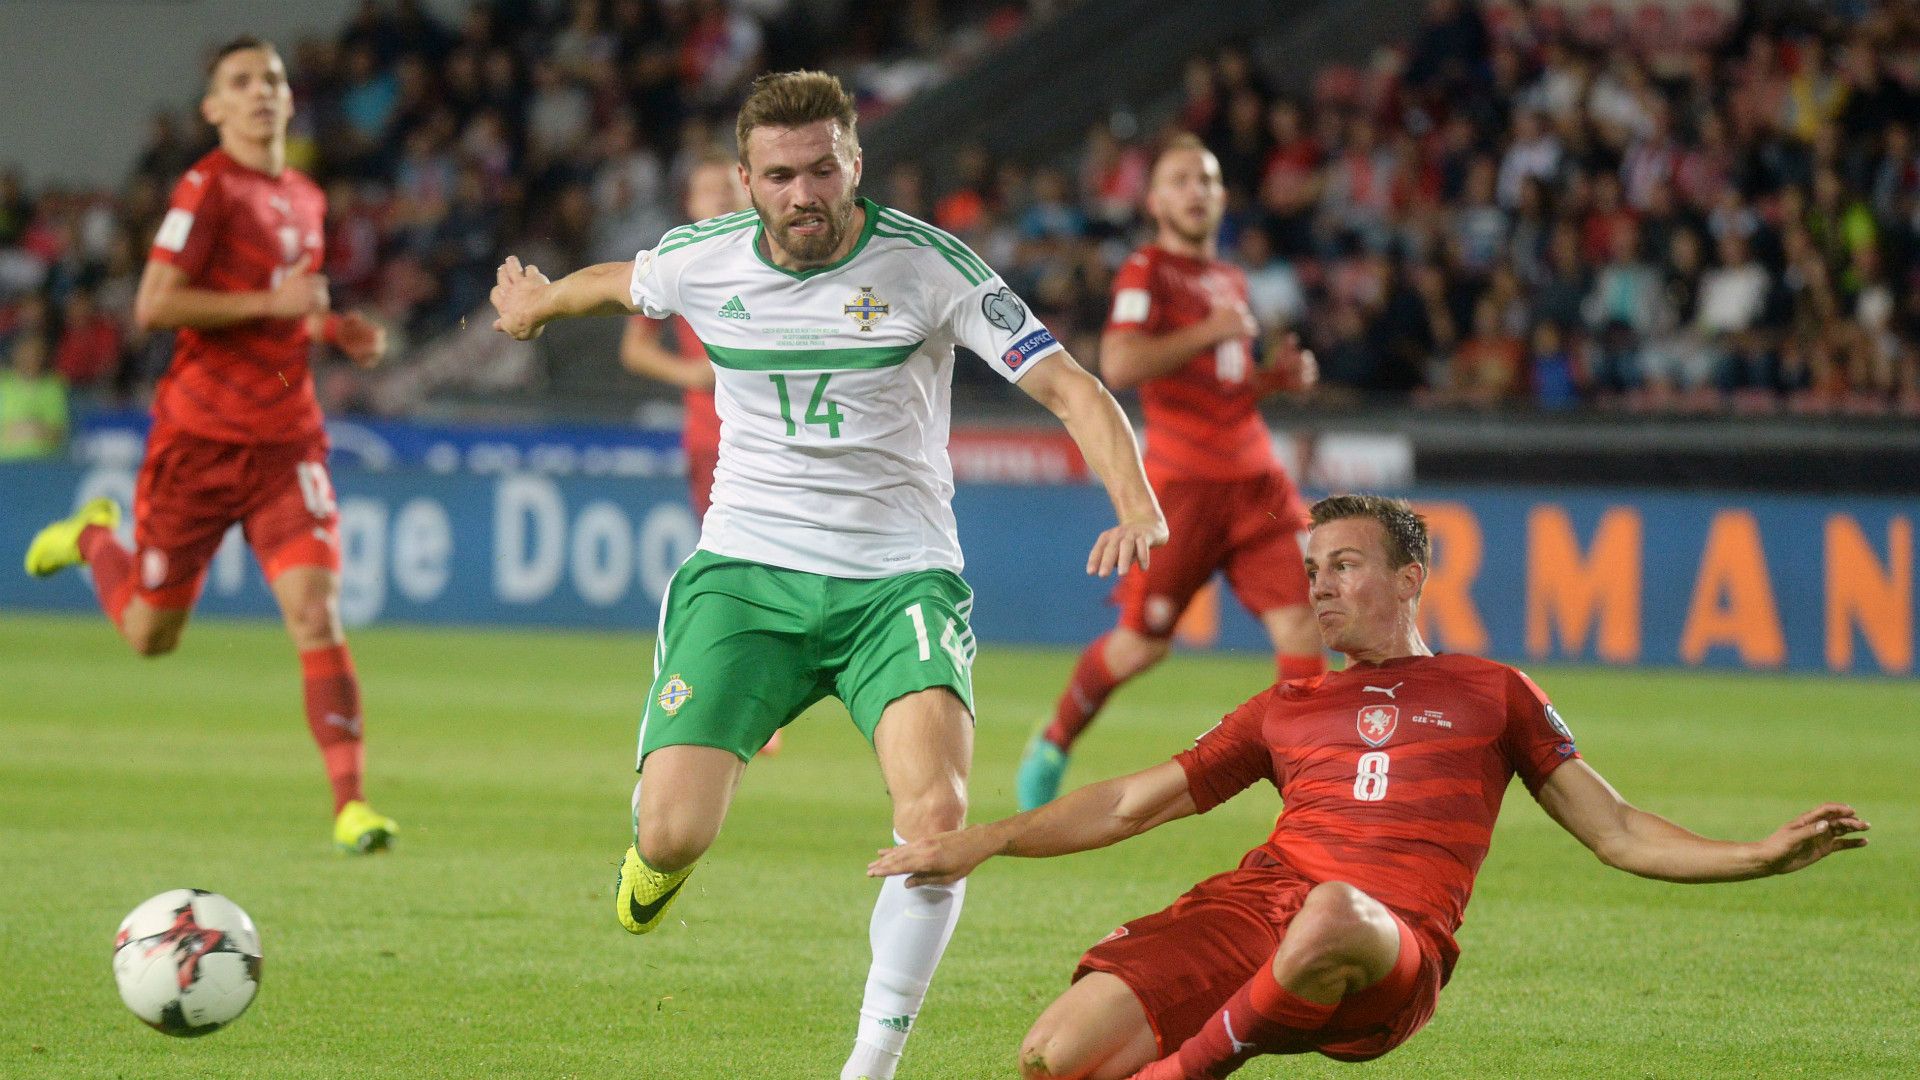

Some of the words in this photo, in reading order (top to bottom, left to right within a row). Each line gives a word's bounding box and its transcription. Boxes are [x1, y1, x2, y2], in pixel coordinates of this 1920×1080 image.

[718, 309, 751, 320] adidas
[769, 373, 844, 438] 14
[1176, 501, 1914, 677] RMAN
[904, 602, 967, 675] 14
[1412, 715, 1428, 724] CZE
[1353, 751, 1390, 802] 8
